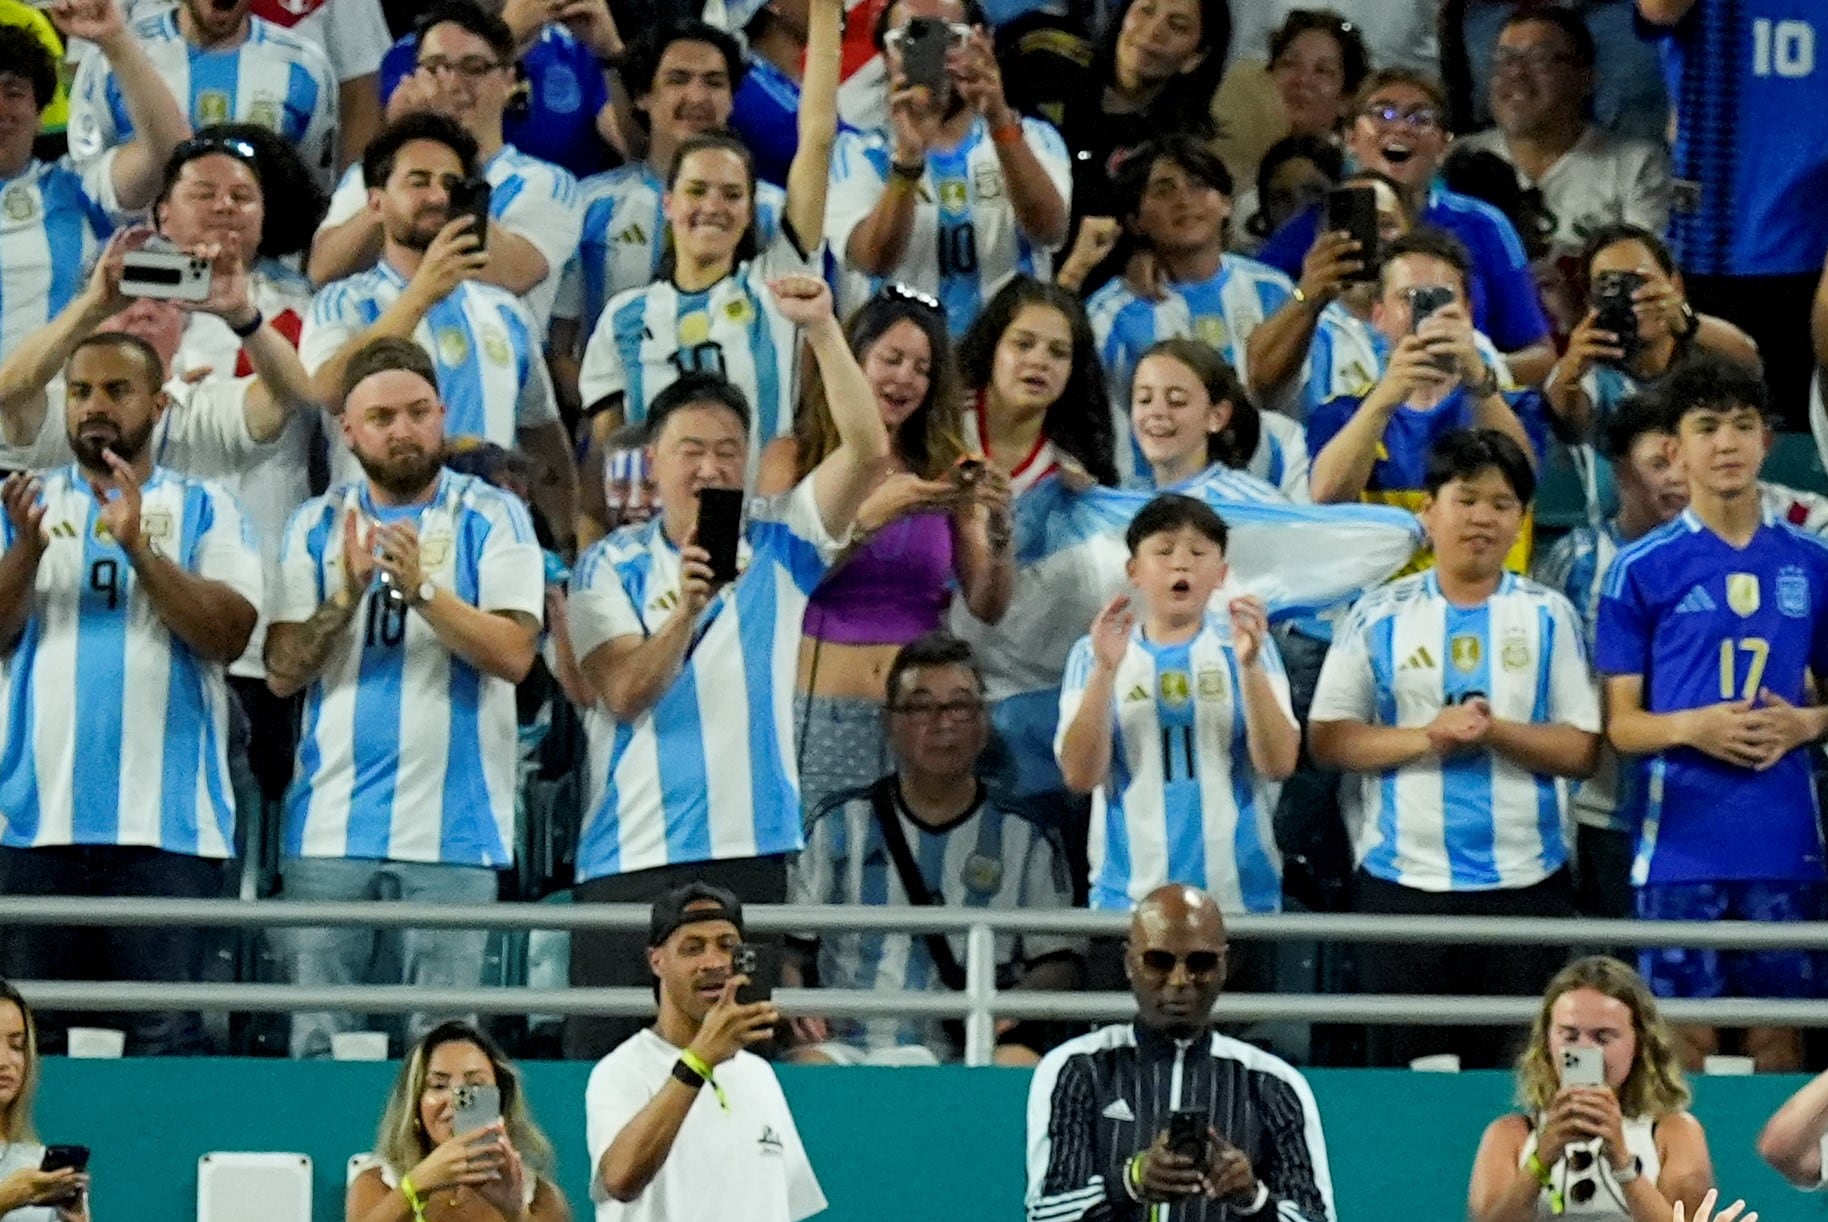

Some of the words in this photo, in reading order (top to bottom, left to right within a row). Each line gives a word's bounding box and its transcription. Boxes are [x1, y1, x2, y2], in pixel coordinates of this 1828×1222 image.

[1752, 18, 1816, 78] 10
[936, 220, 979, 275] 10
[90, 556, 119, 610] 9
[1717, 636, 1771, 700] 17
[1162, 724, 1195, 782] 11
